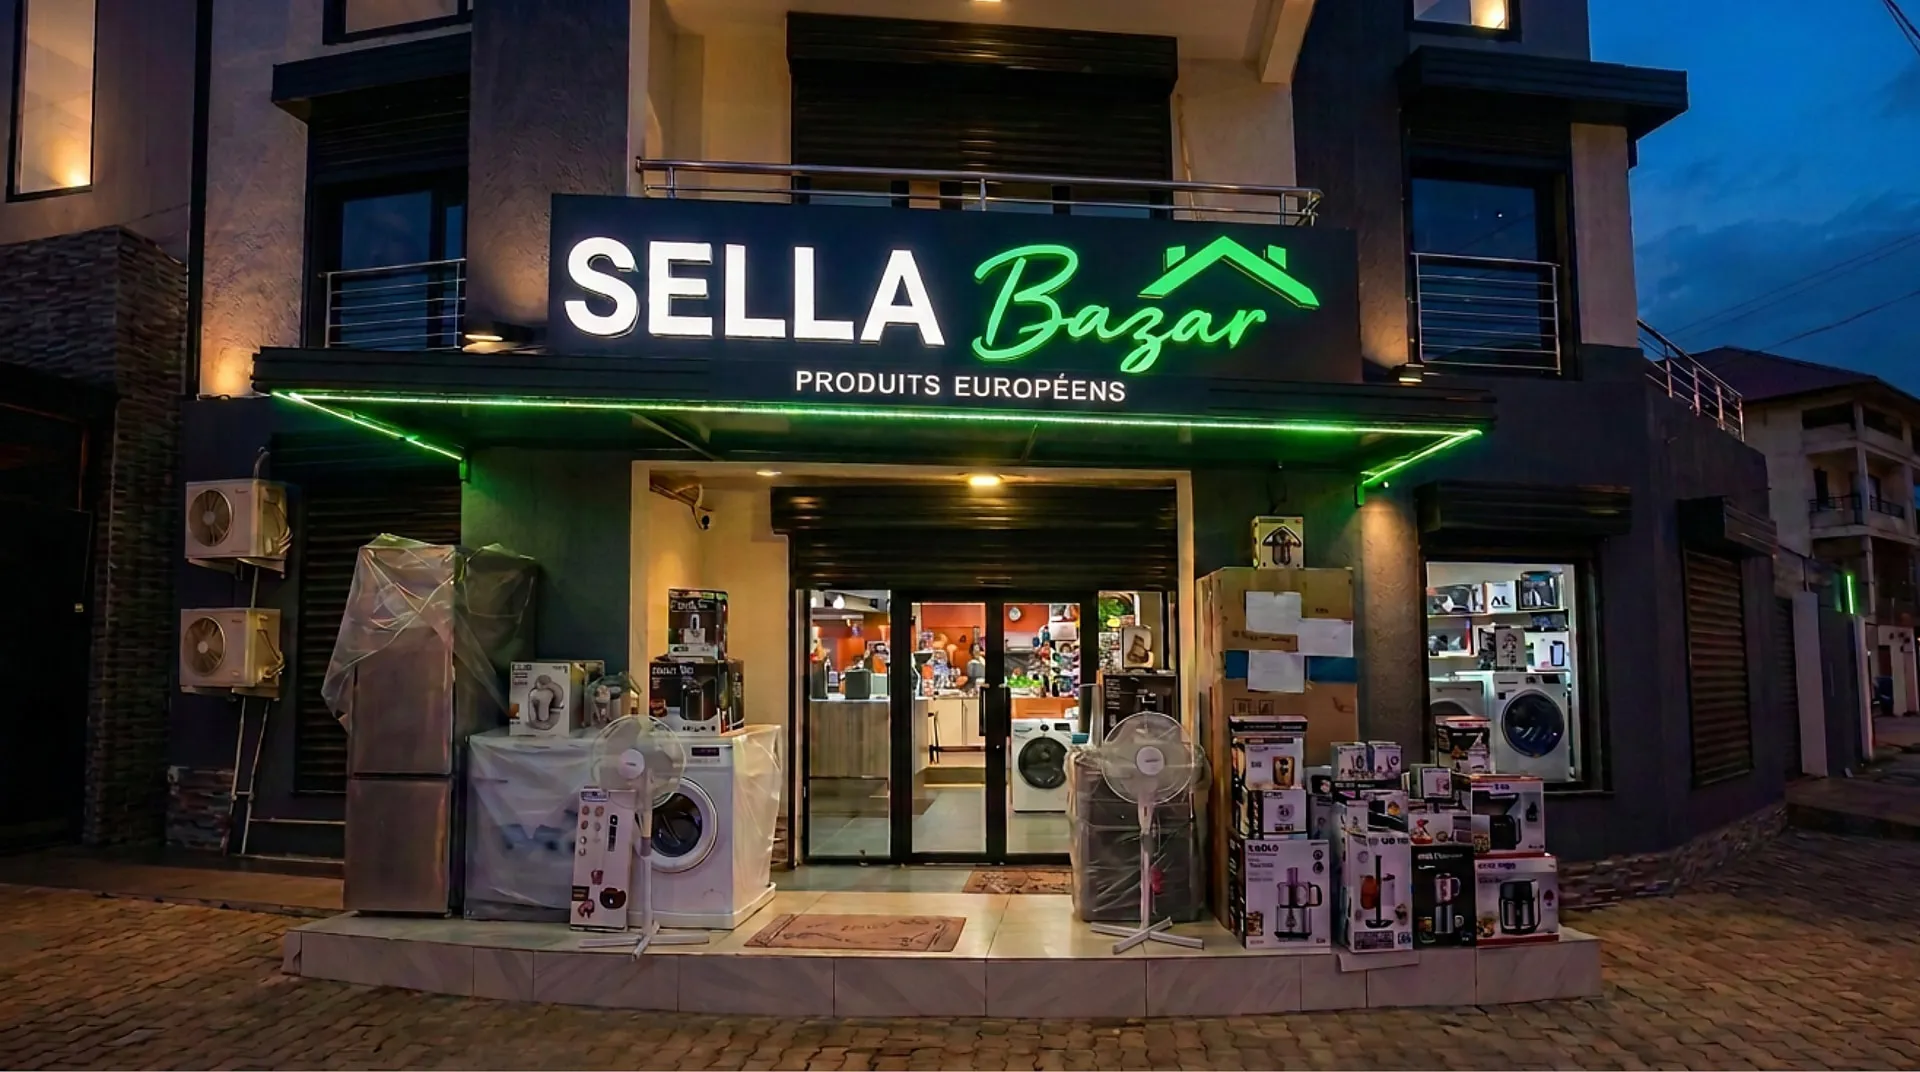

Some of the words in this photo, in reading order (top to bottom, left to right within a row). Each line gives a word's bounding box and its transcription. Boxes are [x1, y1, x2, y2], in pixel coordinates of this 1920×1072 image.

[564, 236, 946, 346] SELLA
[971, 243, 1267, 374] Bazar
[796, 370, 941, 396] PRODUITS
[955, 372, 1126, 402] EUROPÉENS
